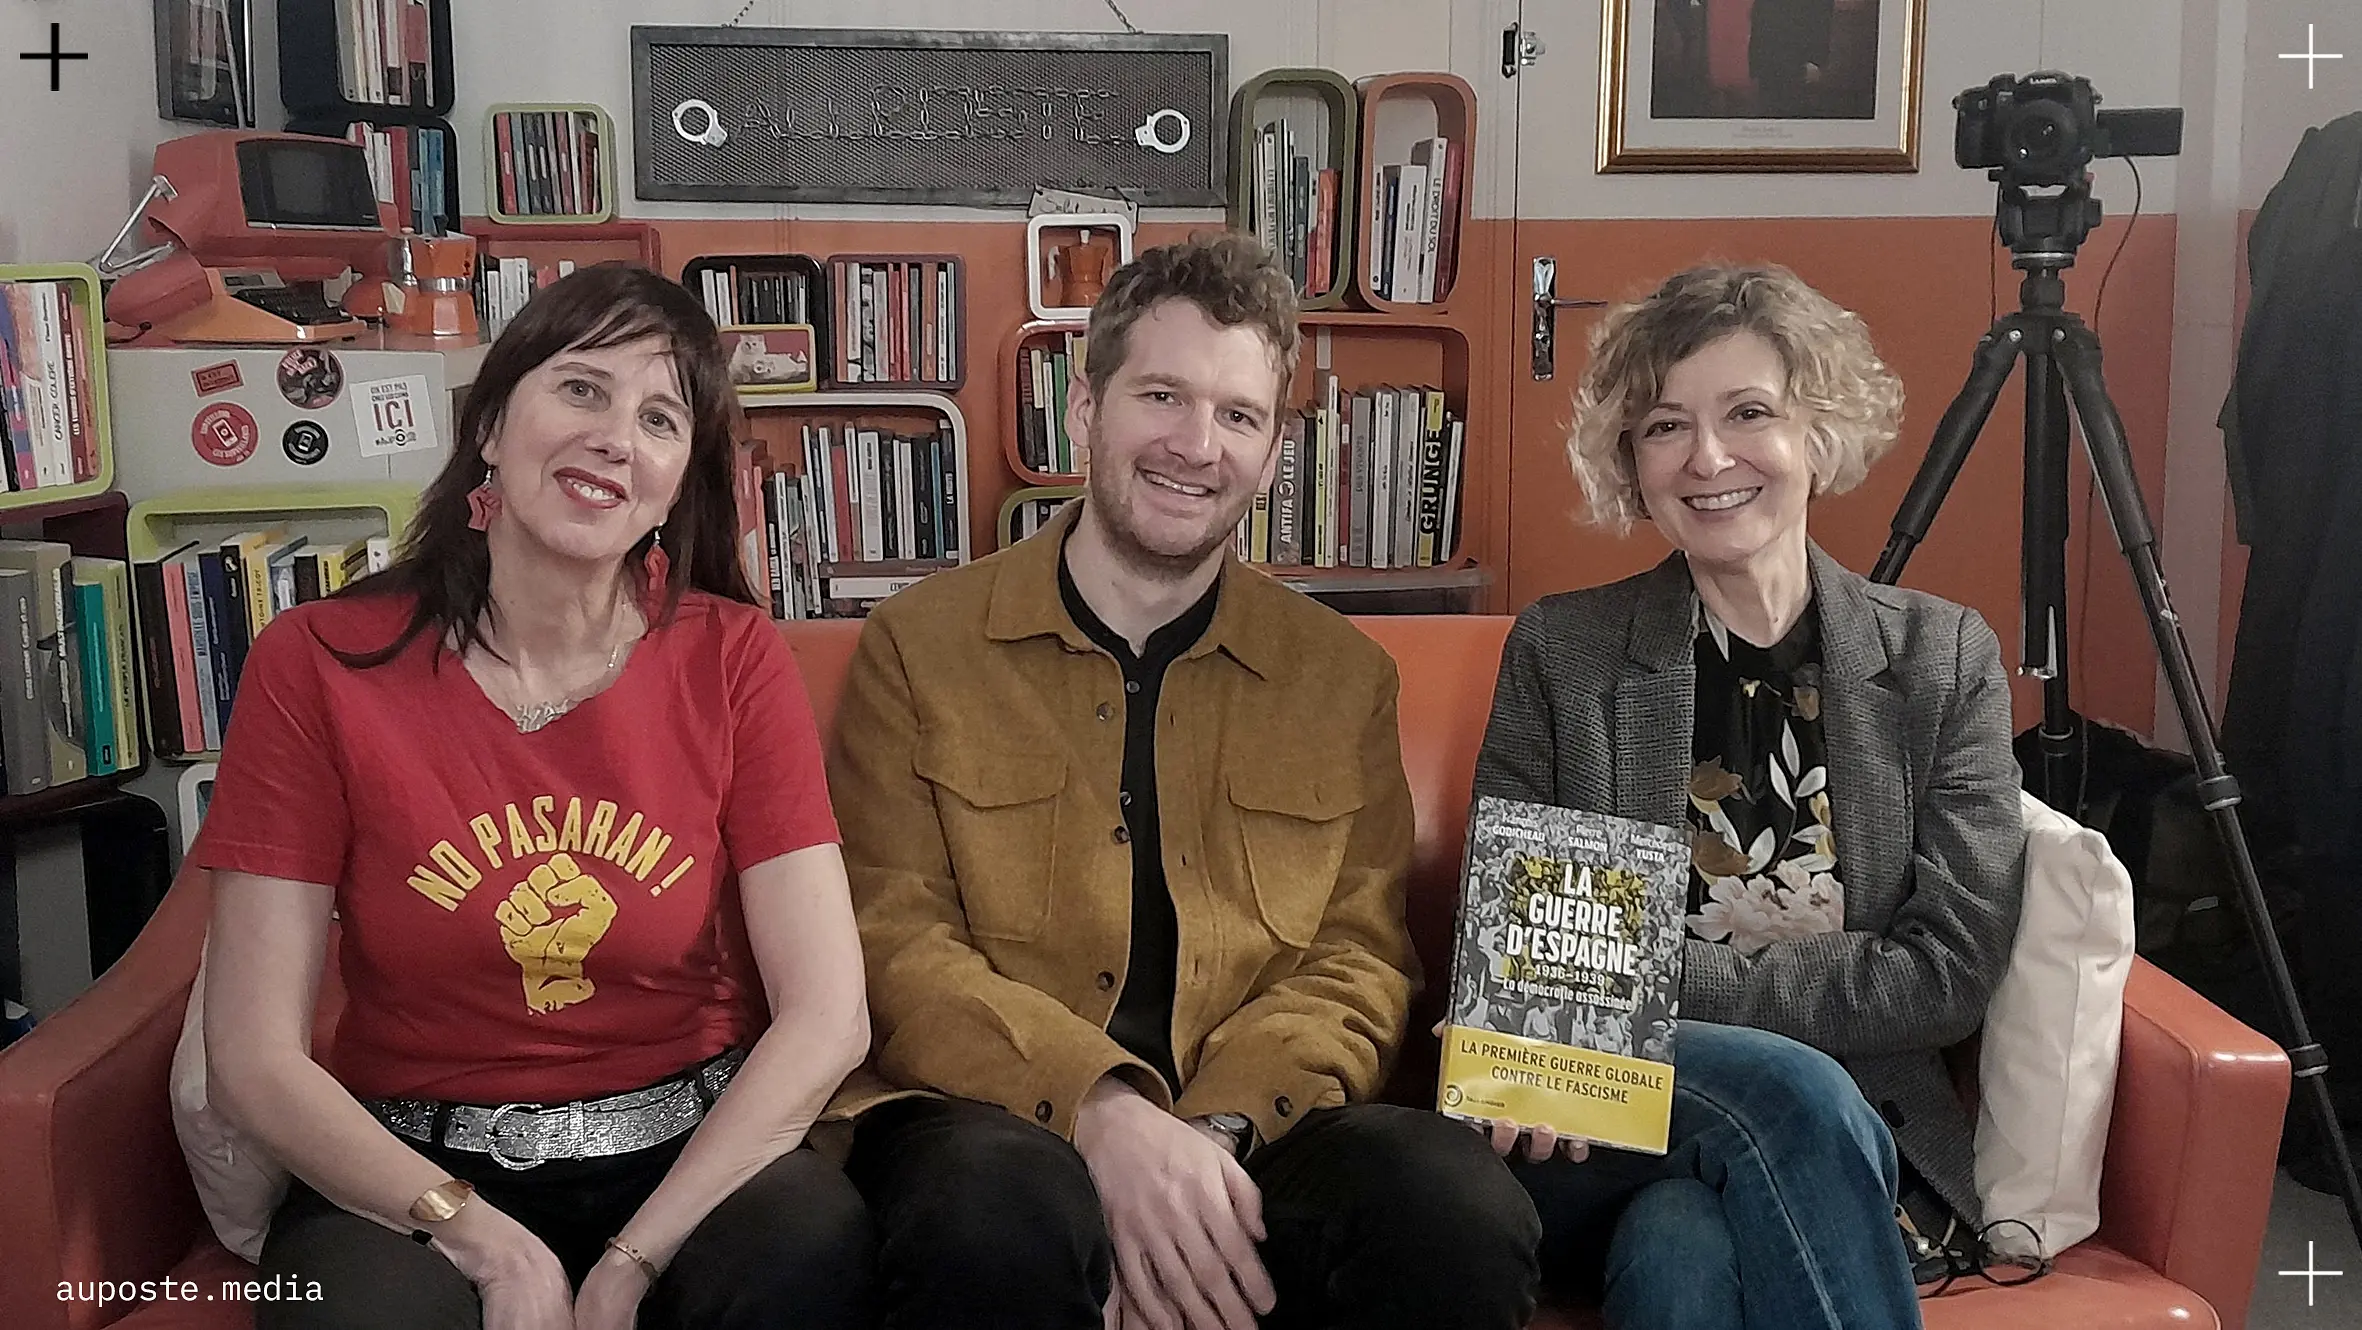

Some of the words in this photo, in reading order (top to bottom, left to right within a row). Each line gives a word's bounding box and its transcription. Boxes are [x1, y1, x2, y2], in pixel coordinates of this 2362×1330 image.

[374, 399, 414, 431] ICI
[1283, 439, 1296, 464] JEU
[1281, 465, 1295, 479] LE
[1279, 498, 1295, 544] ANTIFA
[406, 840, 483, 912] NO
[469, 795, 673, 882] PASARAN
[1568, 836, 1608, 853] SALMON
[1563, 863, 1593, 897] LA
[1528, 893, 1623, 938] GUERRE
[1506, 923, 1638, 976] D'ESPAGNE
[1461, 1039, 1478, 1055] LA
[1481, 1043, 1547, 1068] PREMIÈRE
[1550, 1056, 1601, 1079] GUERRE
[1605, 1067, 1663, 1091] GLOBALE
[1491, 1065, 1543, 1088] CONTRE
[1547, 1077, 1561, 1092] LE
[1566, 1080, 1629, 1104] FASCISME
